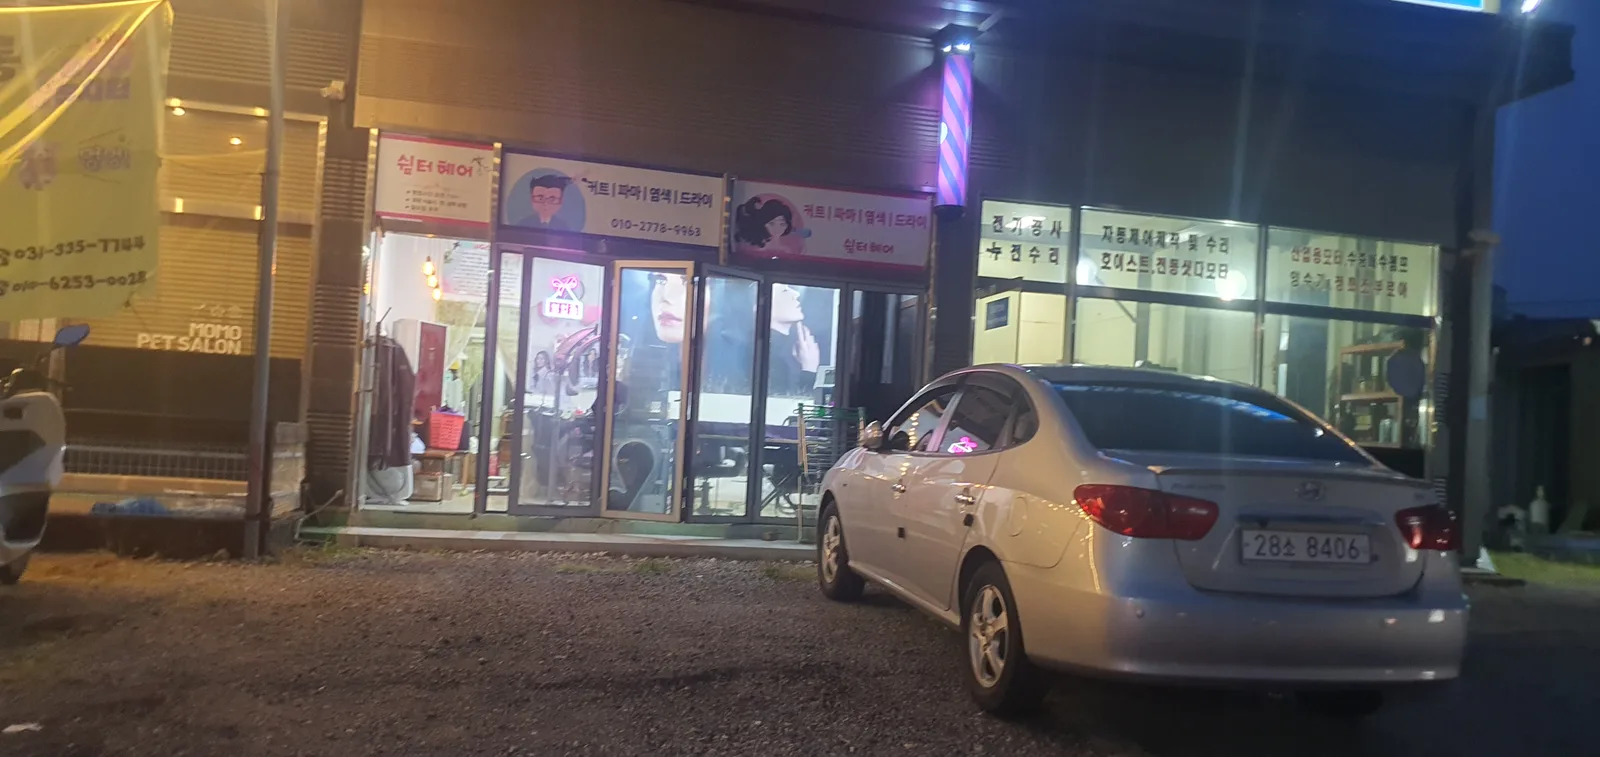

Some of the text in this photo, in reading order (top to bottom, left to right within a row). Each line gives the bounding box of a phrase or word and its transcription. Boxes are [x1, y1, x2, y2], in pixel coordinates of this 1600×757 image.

[611, 218, 702, 237] 010-2778-9963
[189, 323, 242, 340] MOMO
[137, 332, 242, 355] PET SALON
[1307, 536, 1360, 560] 8406
